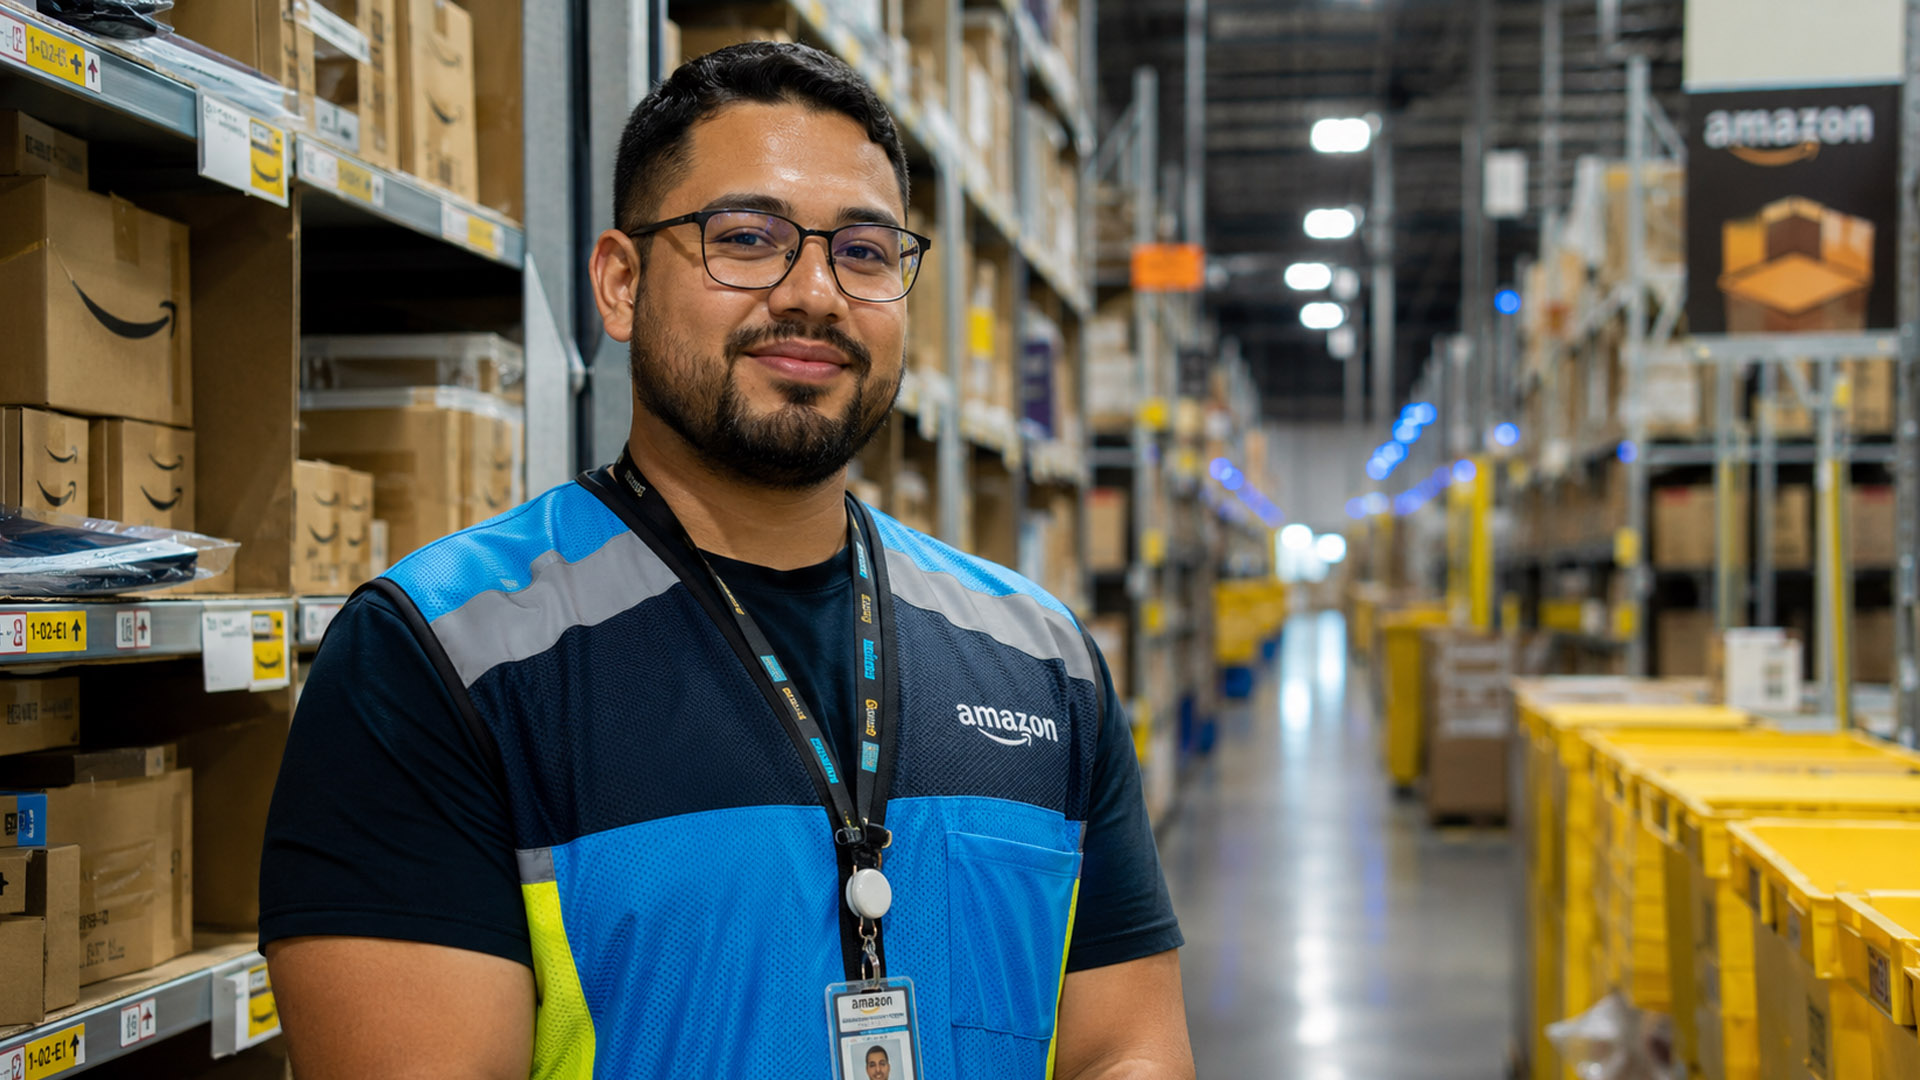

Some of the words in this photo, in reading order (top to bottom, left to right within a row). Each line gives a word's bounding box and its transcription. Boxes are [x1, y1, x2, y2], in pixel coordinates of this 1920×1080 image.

[1704, 105, 1874, 148] amazon
[956, 704, 1059, 742] amazon
[851, 996, 893, 1010] amazon
